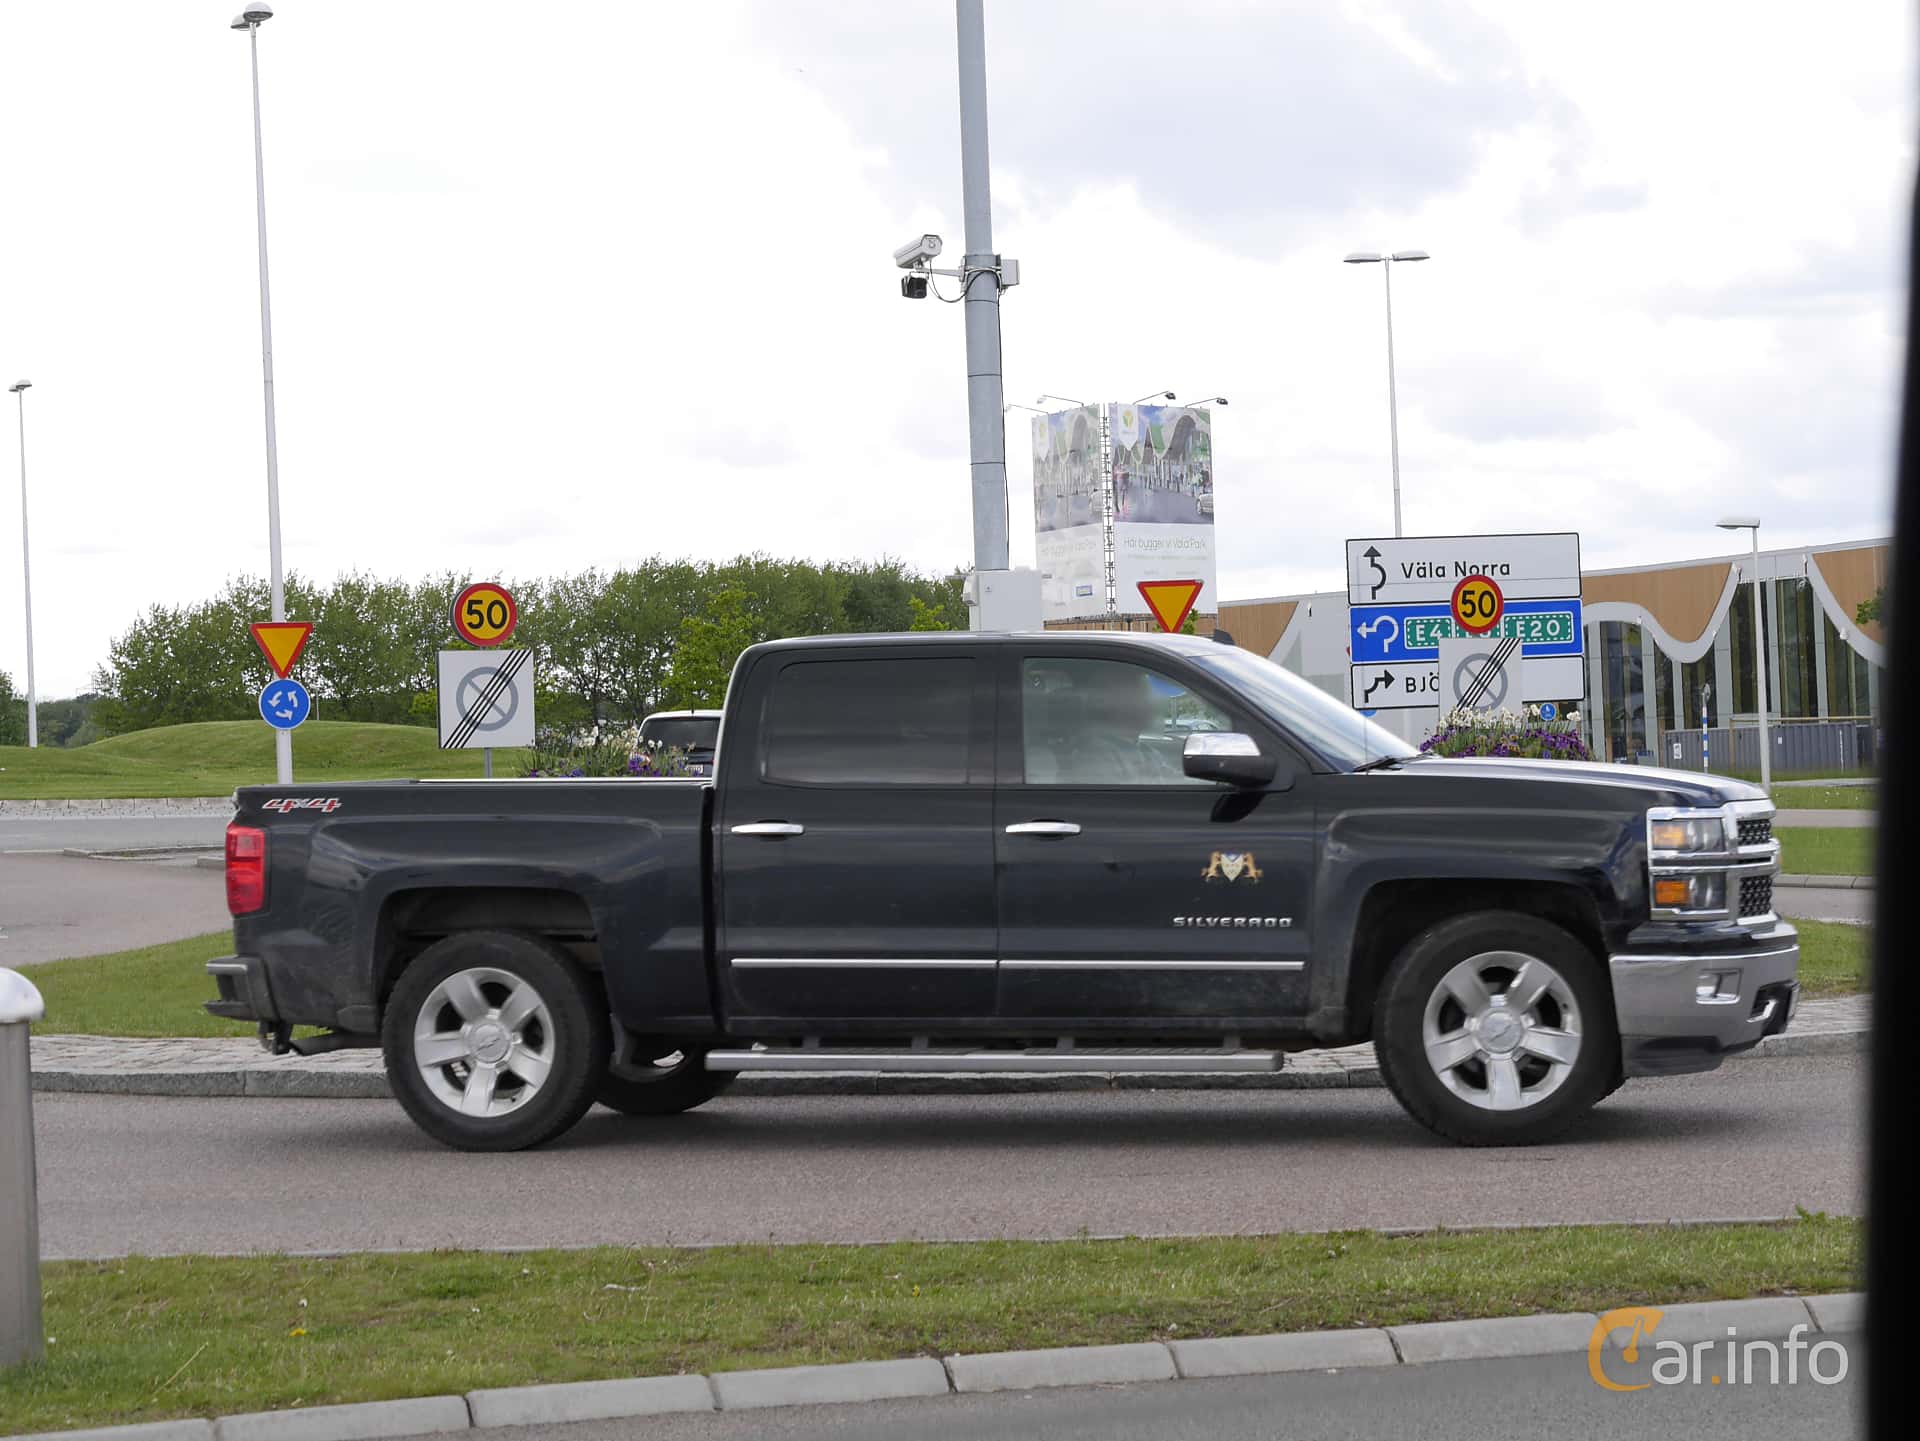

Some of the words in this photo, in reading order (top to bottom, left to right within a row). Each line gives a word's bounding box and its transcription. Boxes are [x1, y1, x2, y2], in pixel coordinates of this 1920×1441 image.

[1401, 561, 1446, 579] Väla
[1454, 560, 1510, 577] Norra
[1461, 589, 1496, 618] 50
[466, 599, 508, 630] 50
[1415, 623, 1443, 642] E4
[1516, 619, 1560, 638] E20
[1173, 916, 1293, 928] SILVERADO
